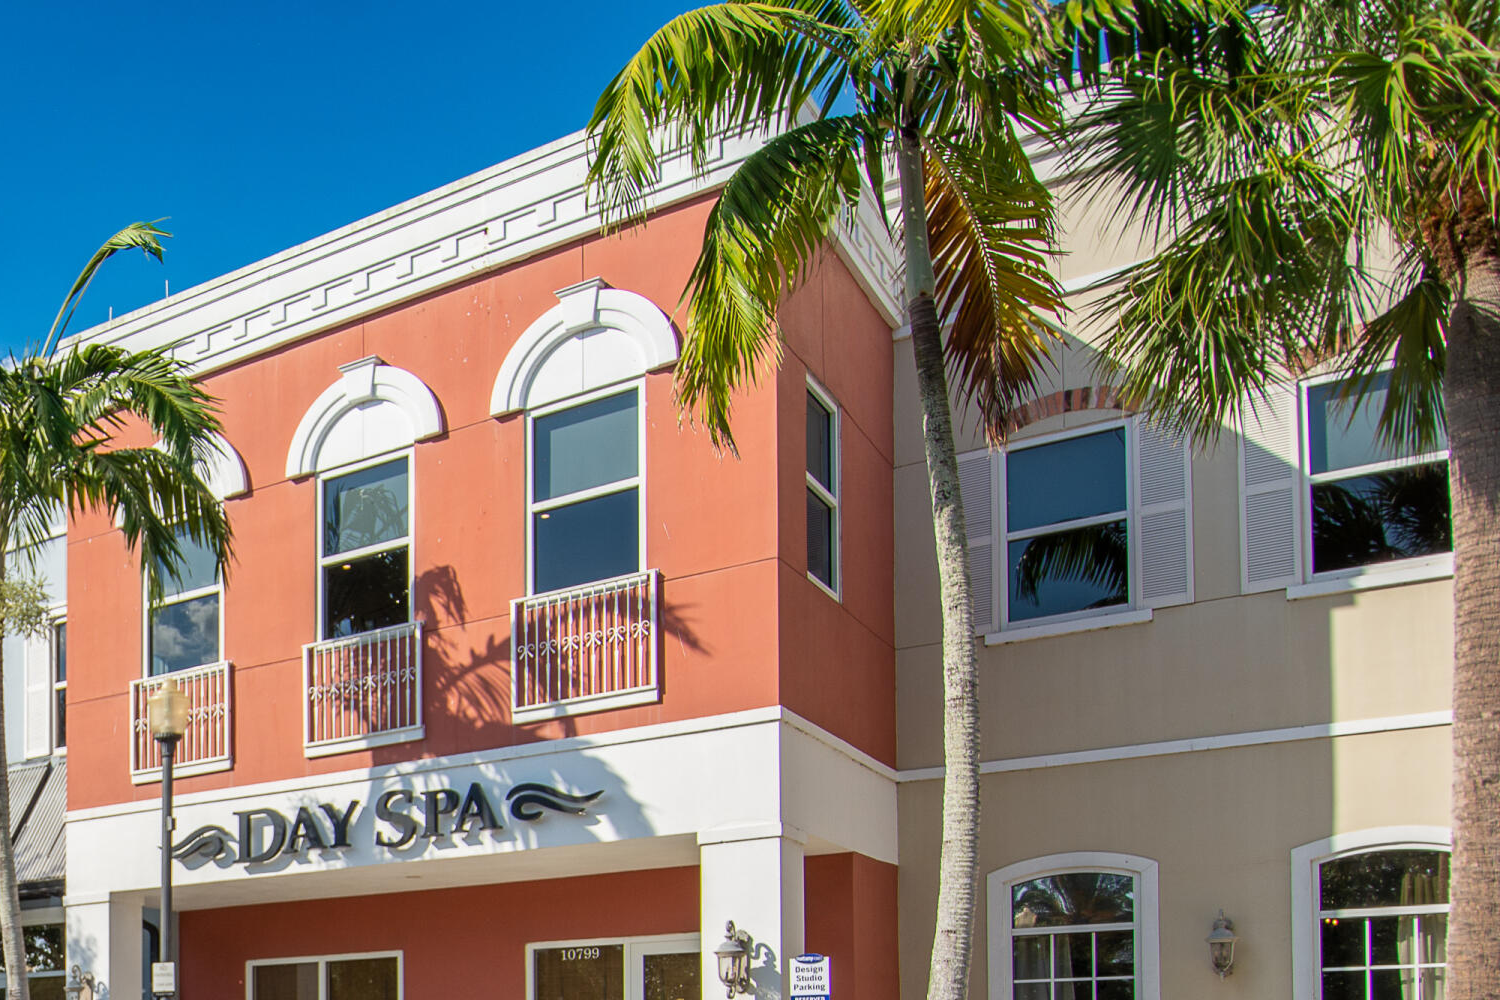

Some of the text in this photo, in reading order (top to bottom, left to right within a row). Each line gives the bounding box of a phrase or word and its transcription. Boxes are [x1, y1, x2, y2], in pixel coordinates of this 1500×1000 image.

[233, 782, 504, 864] DAY SPA
[561, 947, 600, 961] 10799
[795, 966, 823, 974] Design
[796, 974, 823, 982] Studio
[793, 983, 826, 991] Parking
